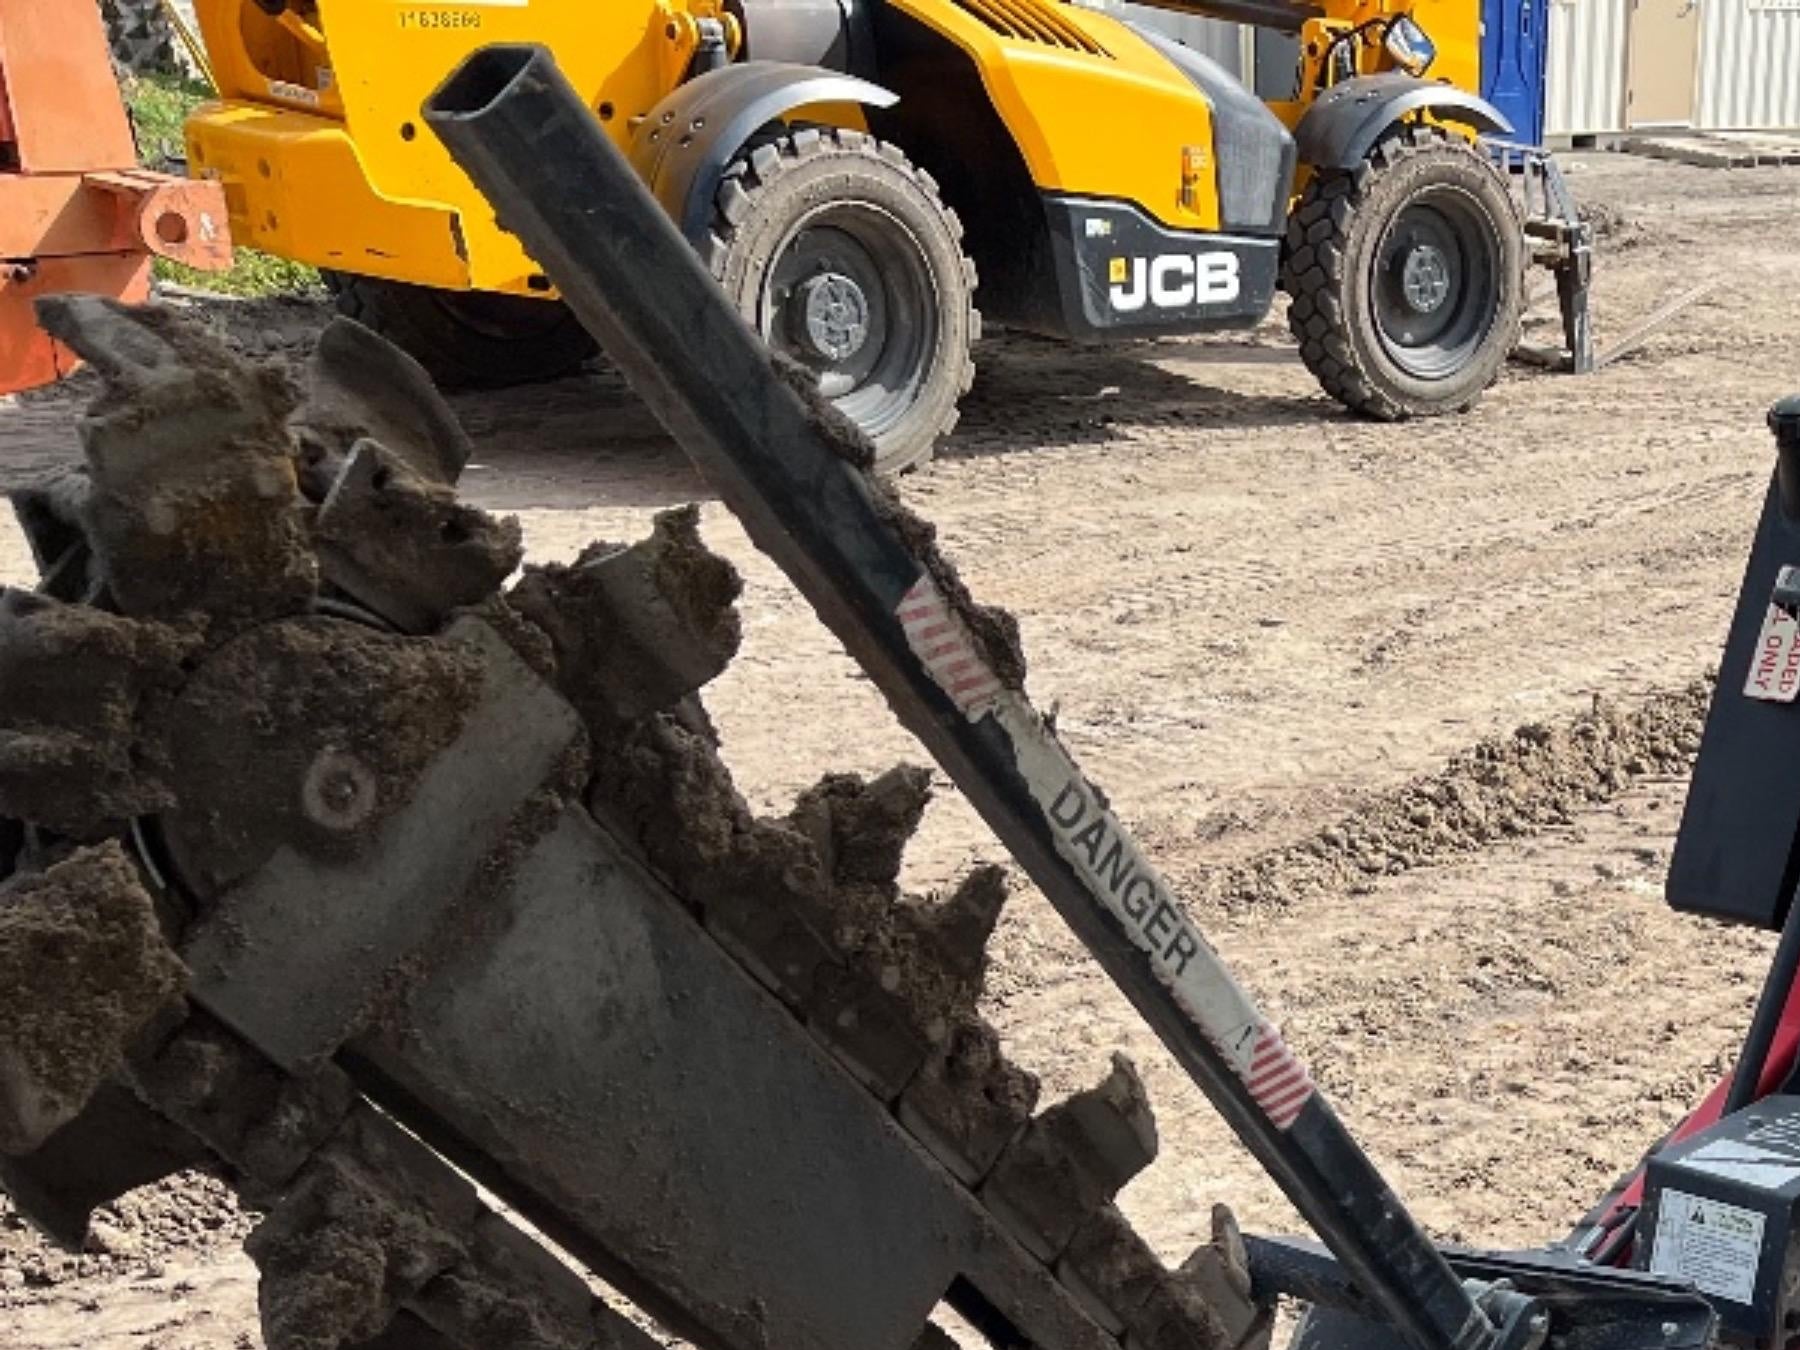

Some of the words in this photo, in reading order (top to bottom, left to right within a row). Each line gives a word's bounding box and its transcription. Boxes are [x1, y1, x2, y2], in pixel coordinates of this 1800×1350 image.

[1109, 251, 1240, 311] JCB
[1755, 634, 1783, 690] ONLY
[1050, 780, 1197, 976] DANGER
